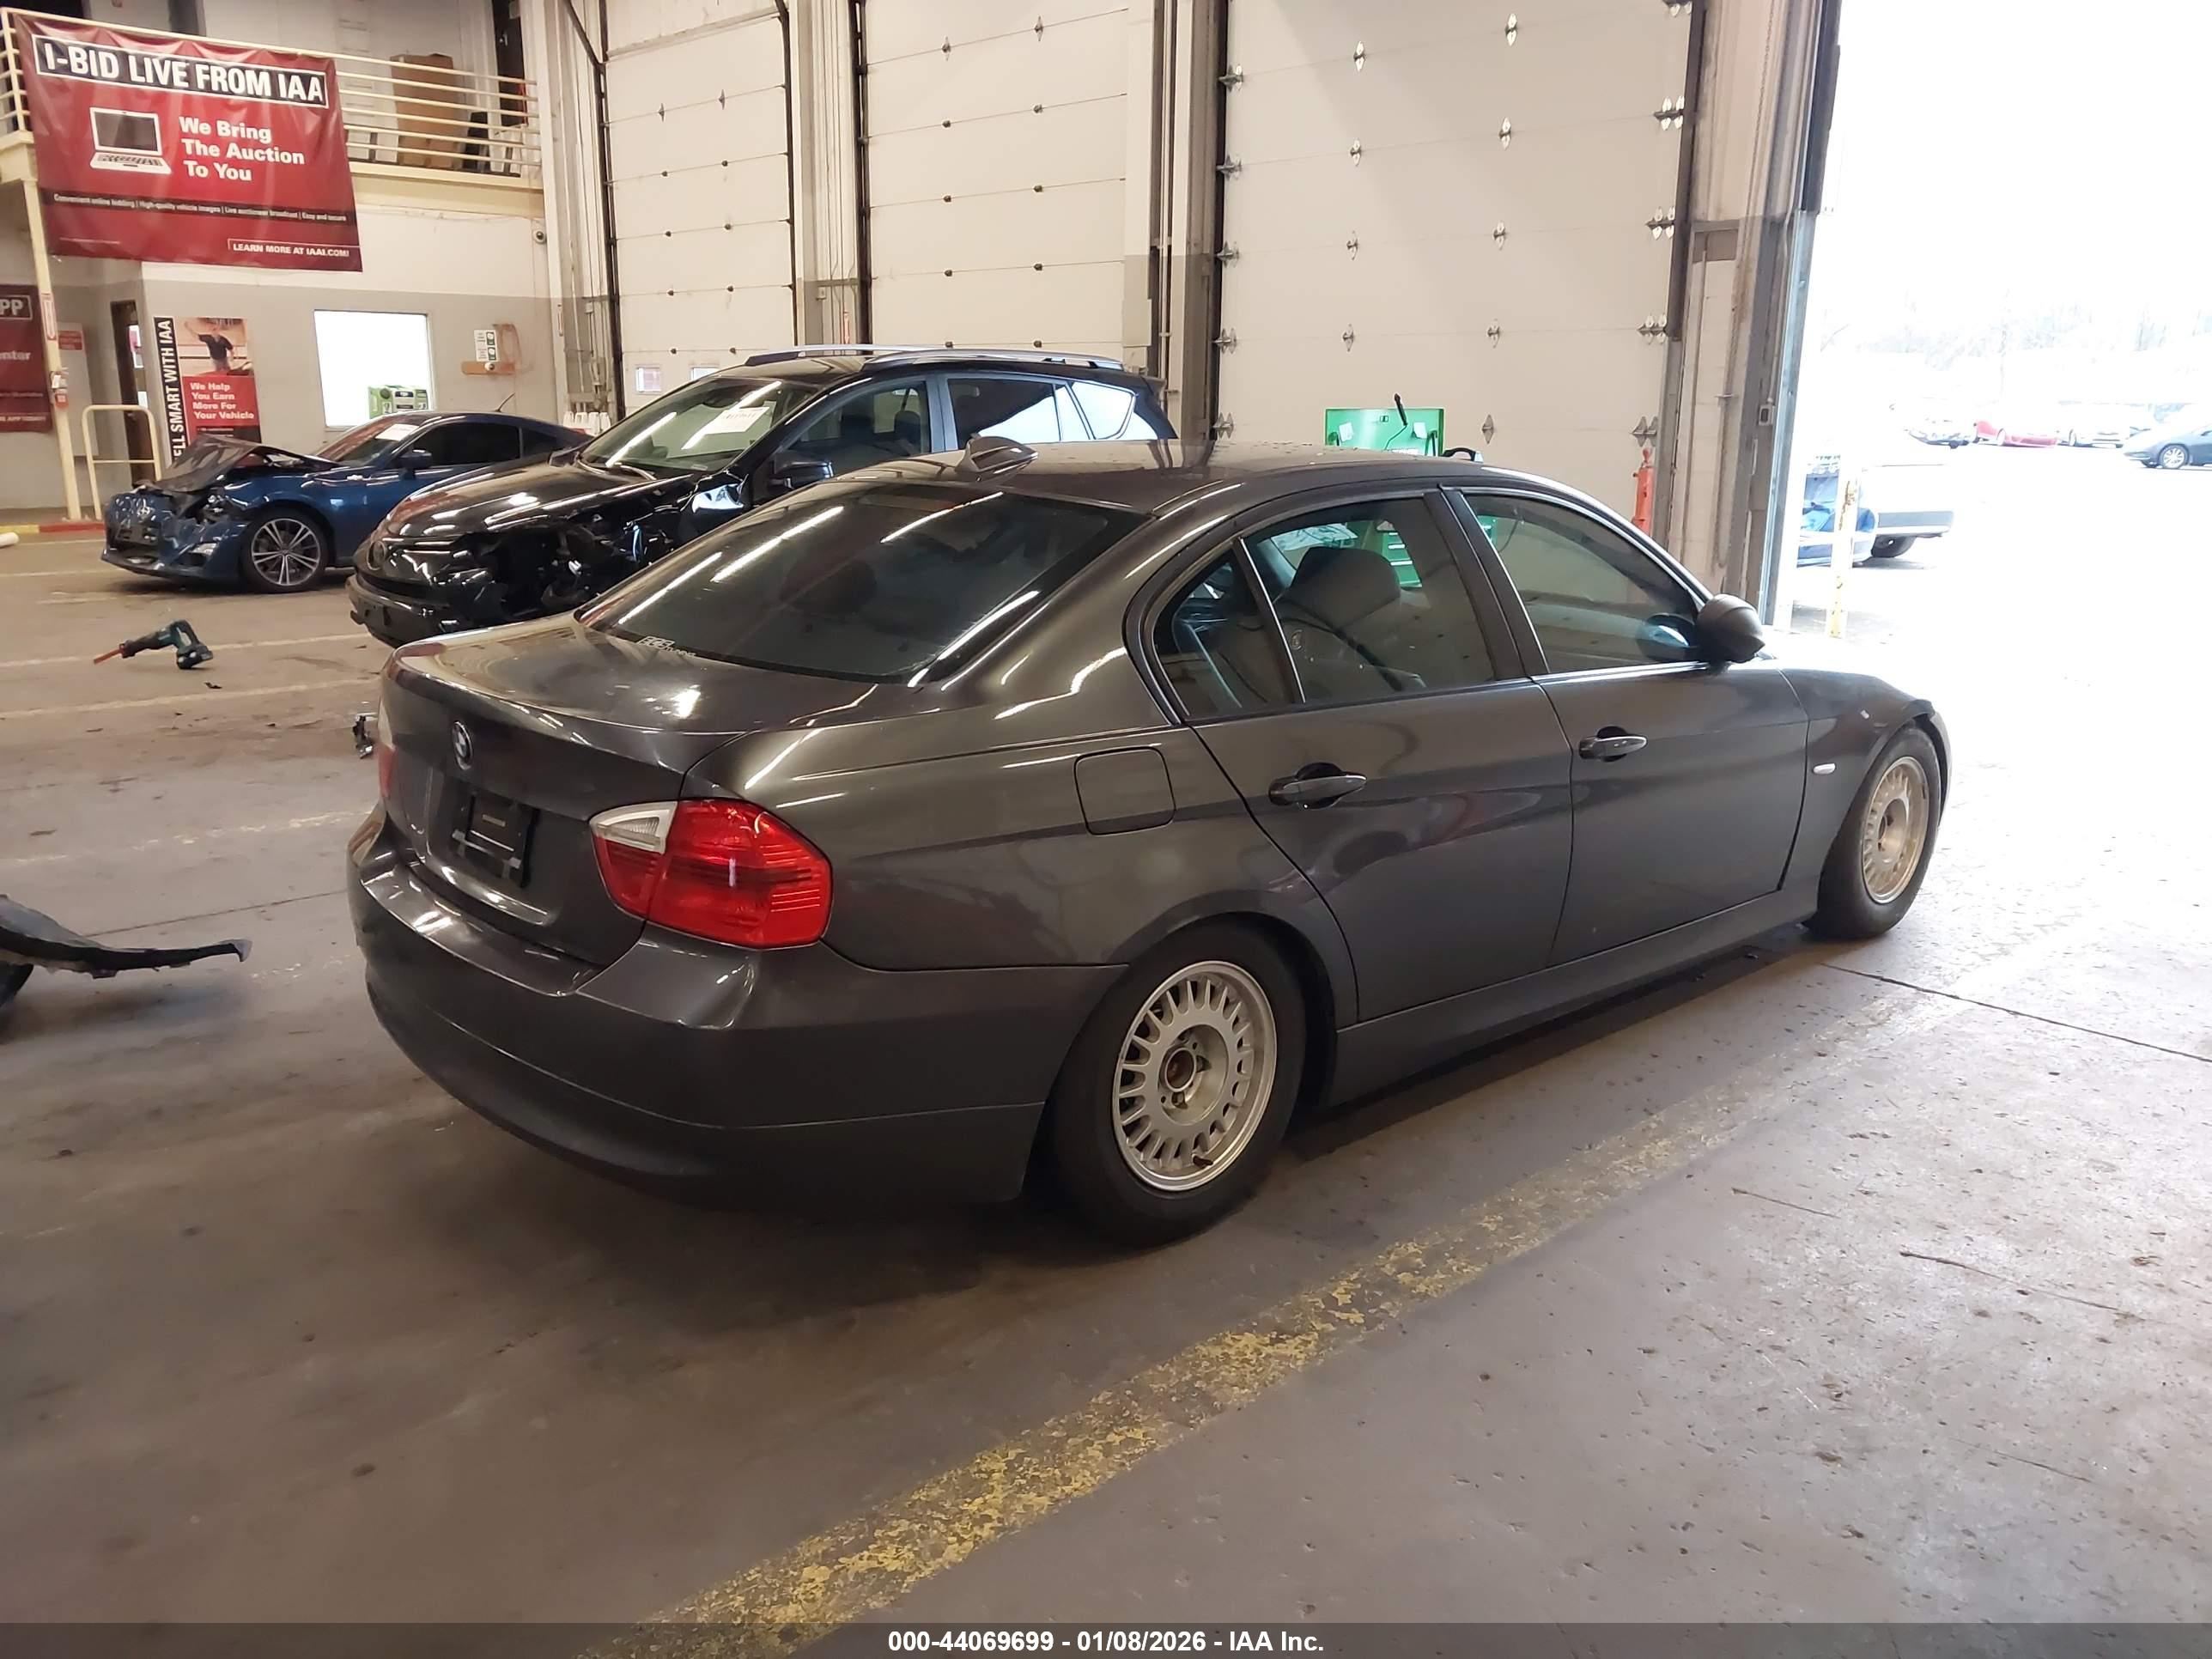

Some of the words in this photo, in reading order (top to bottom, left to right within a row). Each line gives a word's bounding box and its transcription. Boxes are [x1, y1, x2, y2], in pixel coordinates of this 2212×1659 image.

[45, 43, 119, 79] I-BID
[129, 55, 189, 88] LIVE
[195, 64, 271, 97] FROM
[278, 74, 323, 101] IAA
[179, 116, 211, 135] We
[216, 120, 272, 144] Bring
[181, 138, 220, 157] The
[226, 143, 305, 164] Auction
[183, 160, 209, 178] To
[214, 162, 252, 181] You
[233, 243, 263, 252] LEARN
[265, 245, 291, 254] MORE
[293, 246, 304, 255] AT
[158, 320, 173, 343] IAA
[161, 348, 178, 383] WITH
[191, 392, 210, 400] You
[208, 382, 231, 392] Help
[166, 386, 185, 433] SMART
[173, 435, 186, 459] ELL
